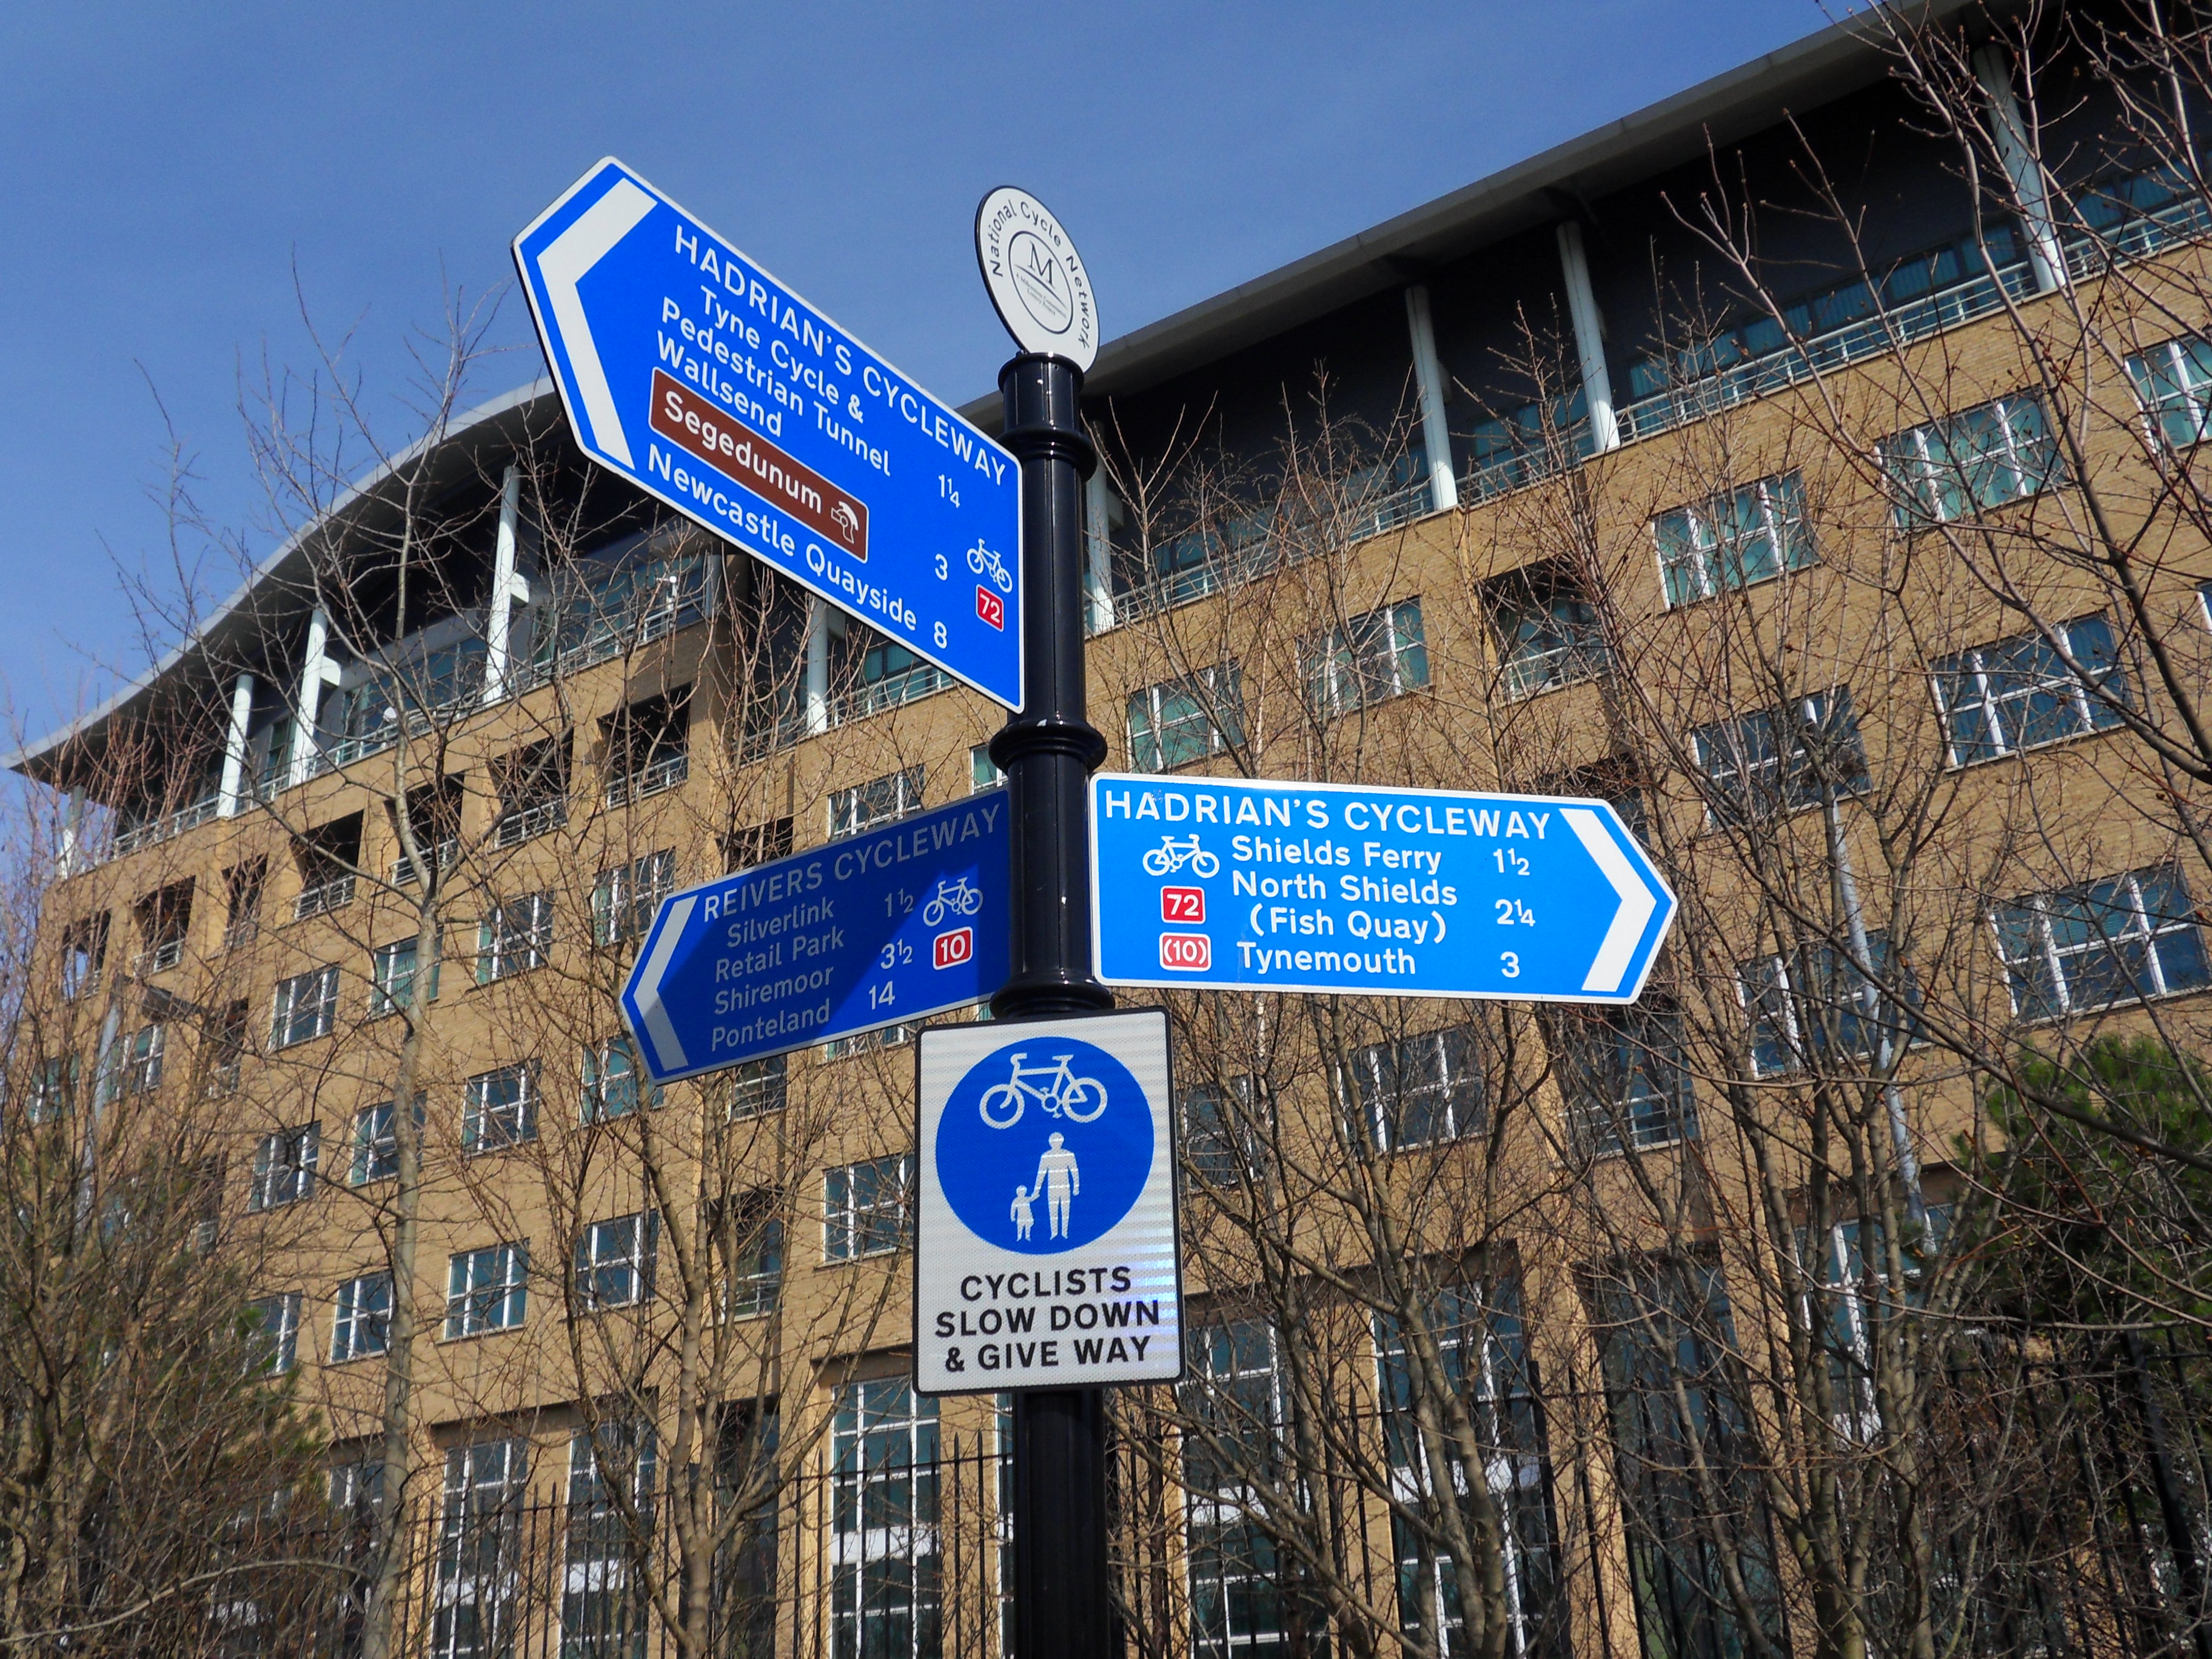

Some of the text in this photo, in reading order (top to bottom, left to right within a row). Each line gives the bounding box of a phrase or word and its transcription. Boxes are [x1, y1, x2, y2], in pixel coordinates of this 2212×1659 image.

[988, 199, 1017, 278] National
[1021, 201, 1061, 247] Cycle
[1066, 255, 1090, 350] Network
[675, 225, 1005, 485] HADRIAN'S CYCLEWAY
[701, 286, 863, 423] Tyne Cycle &
[662, 298, 803, 415] Pedestrian
[814, 401, 890, 476] Tunnel
[658, 330, 947, 580] Wallsend 3
[665, 391, 821, 514] Segedunum
[649, 444, 947, 648] Newcastle Quayside 8
[980, 594, 1000, 623] 72
[1106, 791, 1550, 839] HADRIAN'S CYCLEWAY
[705, 803, 999, 922] REIVERS CYCLEWAY
[1232, 836, 1350, 865] Shields
[1364, 842, 1441, 875] Ferry
[1167, 894, 1199, 916] 72
[1233, 870, 1457, 905] North Shields
[728, 897, 834, 947] Silverlink
[1250, 904, 1446, 944] (Fish Quay)
[716, 928, 843, 982] Retail Park
[941, 936, 965, 962] 10
[1163, 939, 1208, 965] (10)
[1237, 942, 1520, 977] Tynemouth 3
[715, 967, 833, 1014] Shiremoor
[712, 981, 895, 1051] Ponteland 14
[960, 1267, 1130, 1301] CYCLISTS
[936, 1299, 1159, 1338] SLOW DOWN
[945, 1336, 1150, 1372] & GIVE WAY
